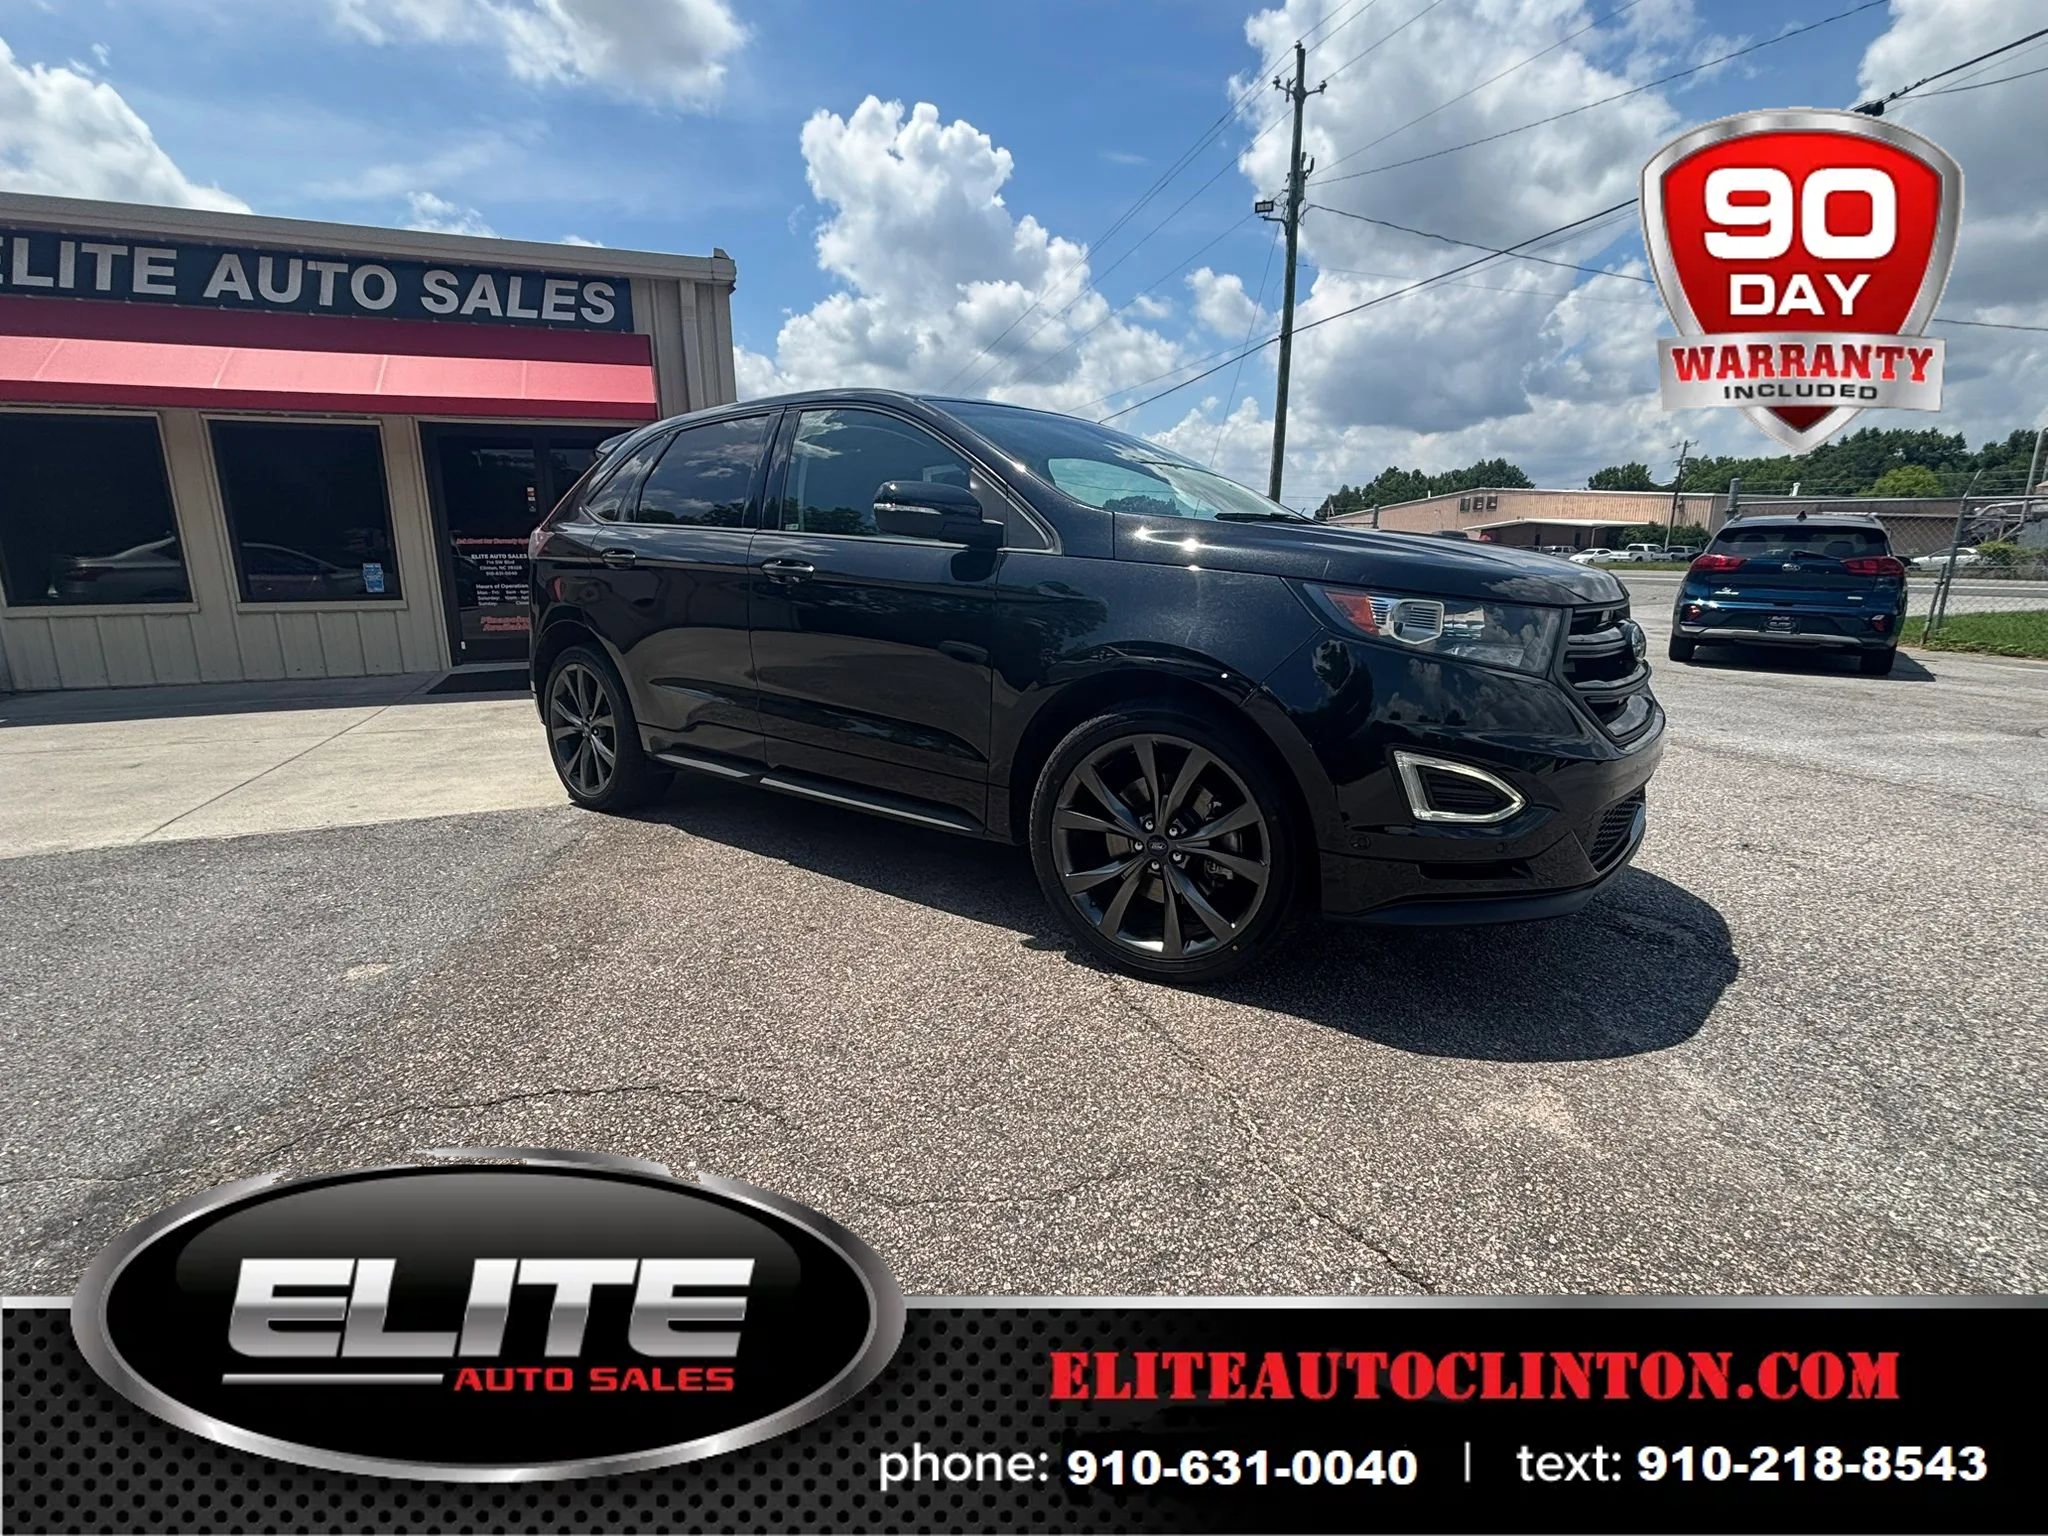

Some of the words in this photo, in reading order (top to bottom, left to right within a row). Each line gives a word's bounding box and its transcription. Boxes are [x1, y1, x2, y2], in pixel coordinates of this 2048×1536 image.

[0, 236, 178, 296] LITE
[203, 253, 398, 311] AUTO
[420, 269, 616, 324] SALES
